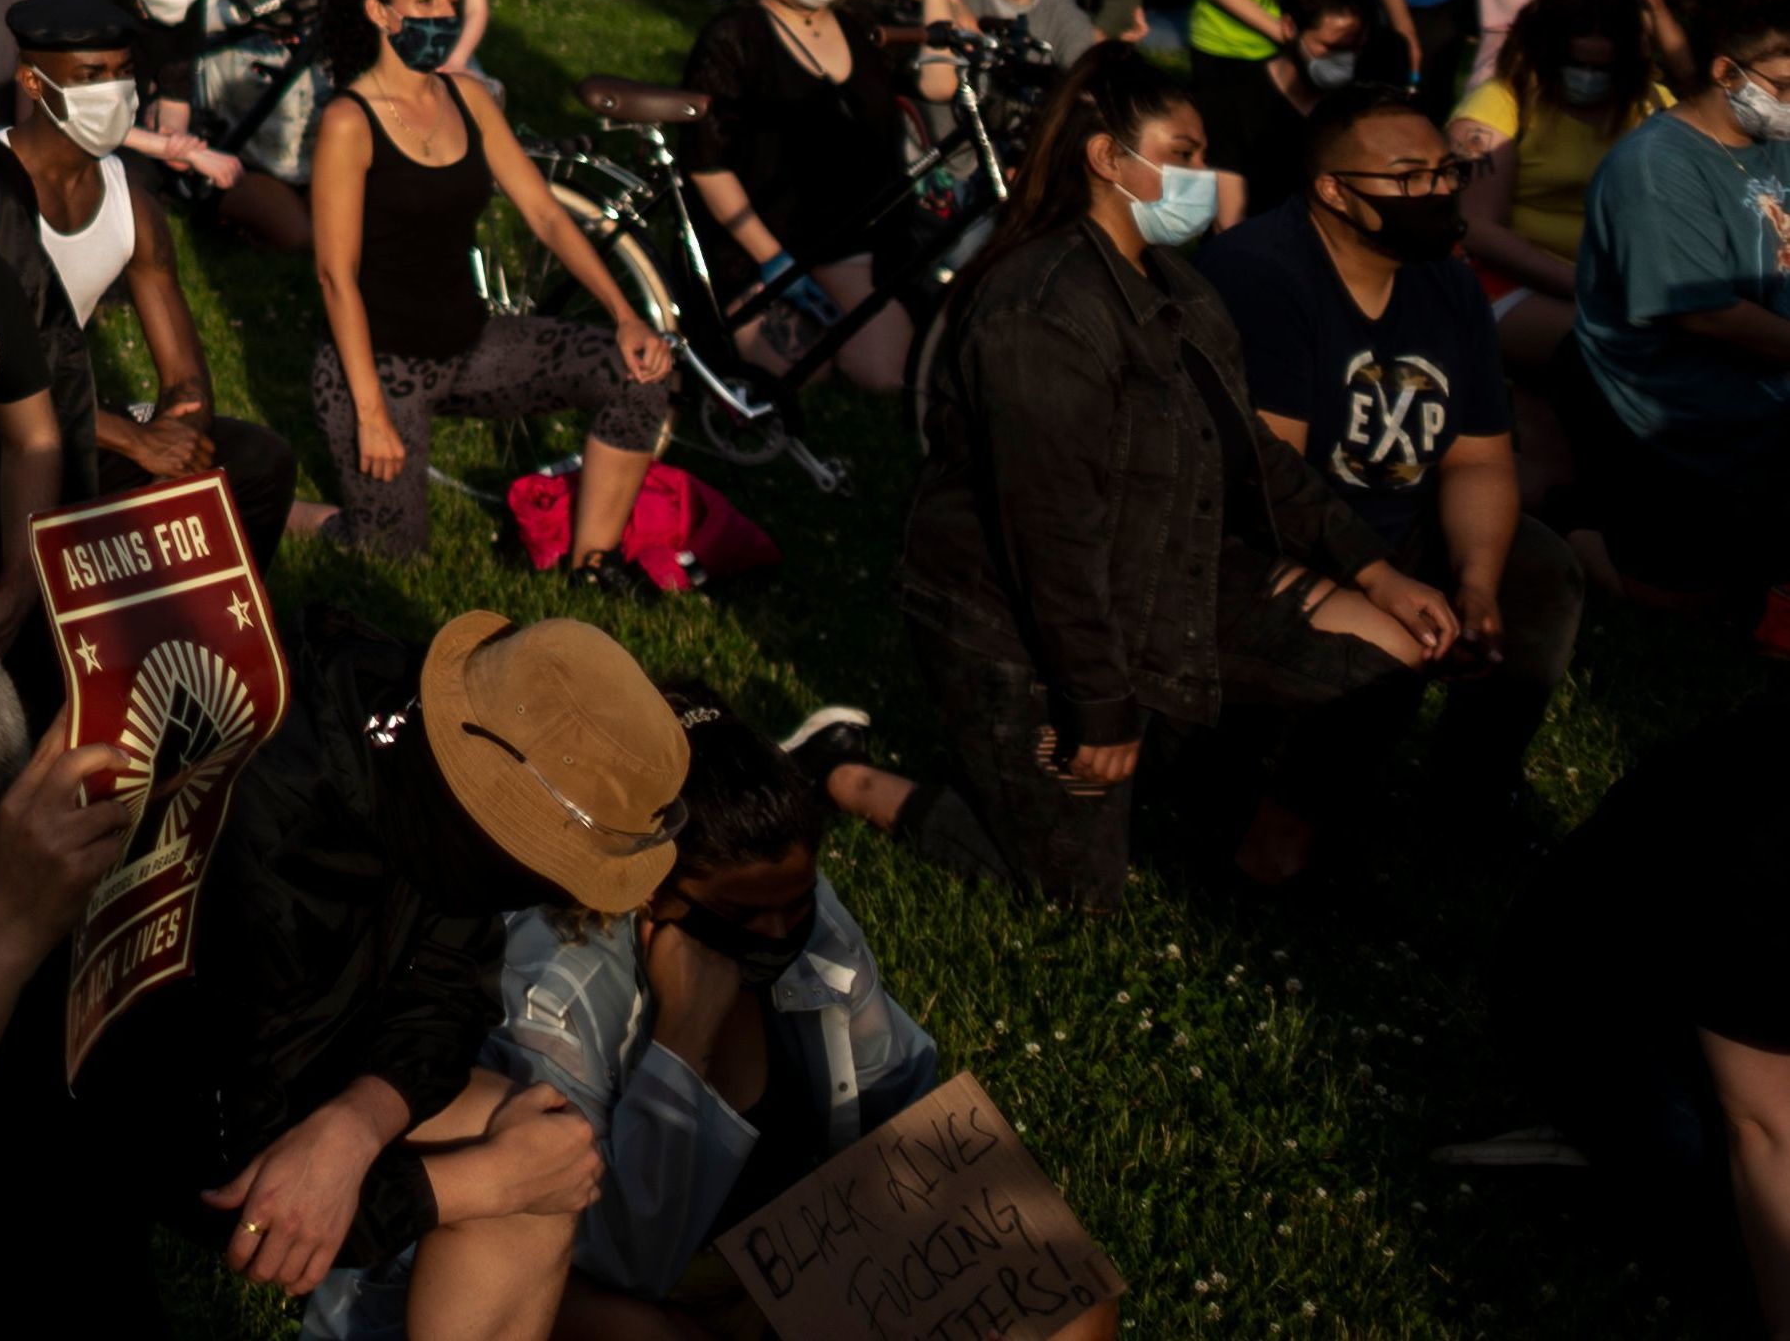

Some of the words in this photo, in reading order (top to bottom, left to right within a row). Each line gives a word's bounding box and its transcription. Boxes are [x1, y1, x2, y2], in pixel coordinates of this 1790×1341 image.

[1347, 380, 1446, 466] EXP
[61, 529, 154, 593] ASIANS
[152, 514, 211, 567] FOR
[120, 905, 183, 980] LIVES
[745, 1178, 882, 1299] BLACK
[874, 1105, 1000, 1214] LIVES
[846, 1187, 1039, 1341] FUCKING
